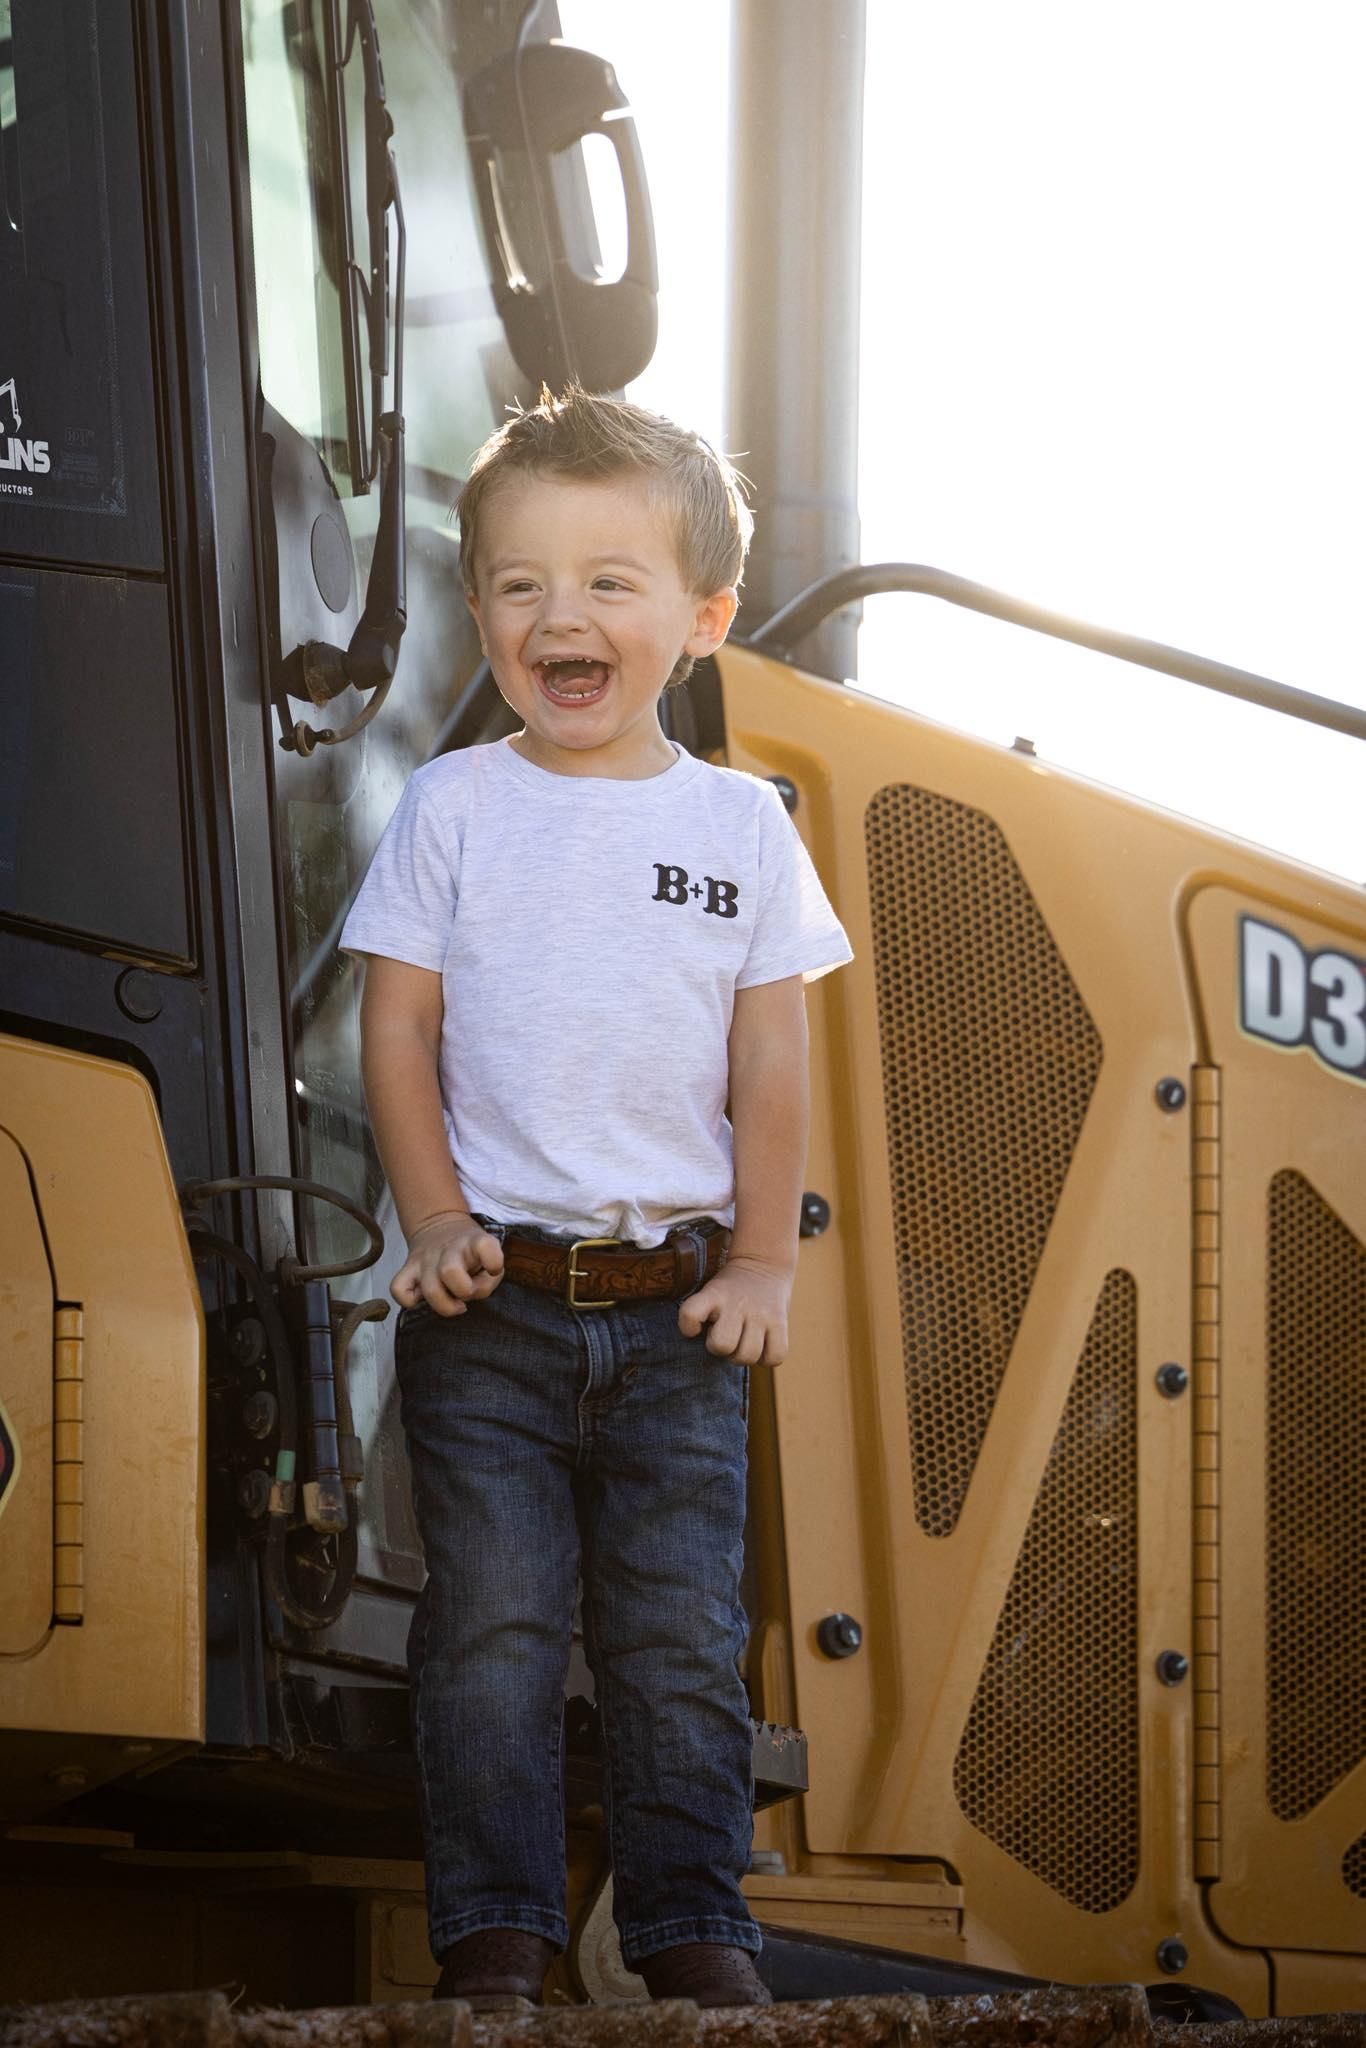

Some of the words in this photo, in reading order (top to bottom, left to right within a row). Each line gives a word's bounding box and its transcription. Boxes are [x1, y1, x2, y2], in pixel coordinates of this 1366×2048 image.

[0, 483, 33, 496] UCTORS
[651, 862, 739, 919] B+B
[1241, 917, 1366, 1073] D3
